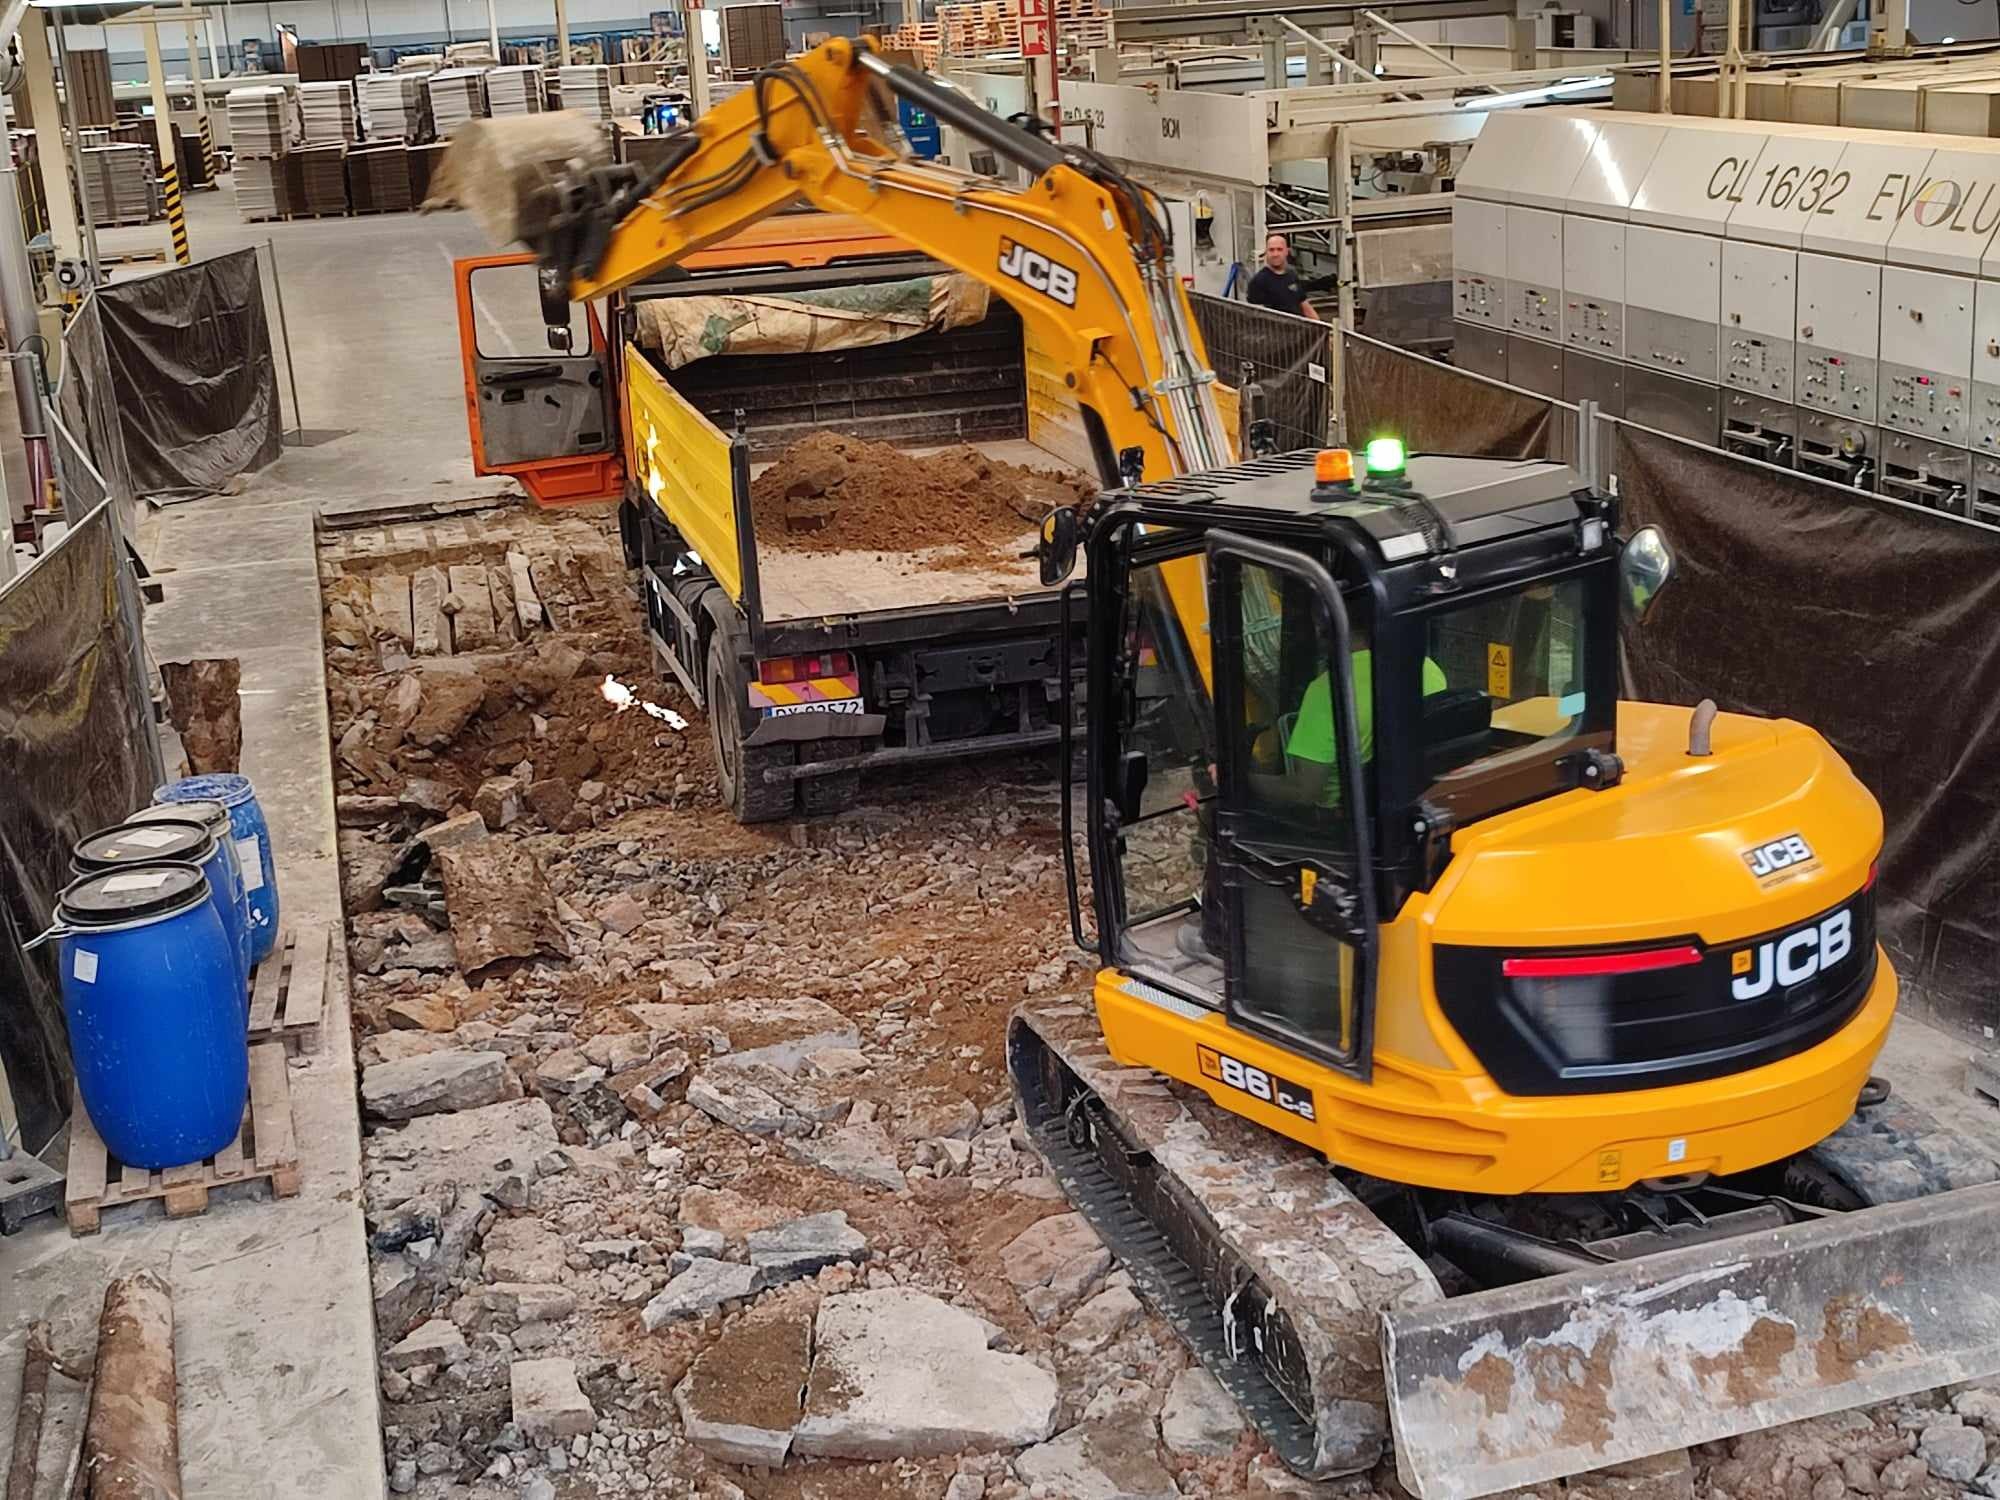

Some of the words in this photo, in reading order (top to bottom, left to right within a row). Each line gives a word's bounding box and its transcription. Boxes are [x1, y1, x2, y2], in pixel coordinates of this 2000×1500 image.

[1706, 157, 1750, 203] CL
[1756, 164, 1851, 215] 16/32
[999, 244, 1076, 305] JCB
[1752, 836, 1812, 876] JCB
[1732, 909, 1851, 1001] JCB
[1220, 1055, 1272, 1100] 86
